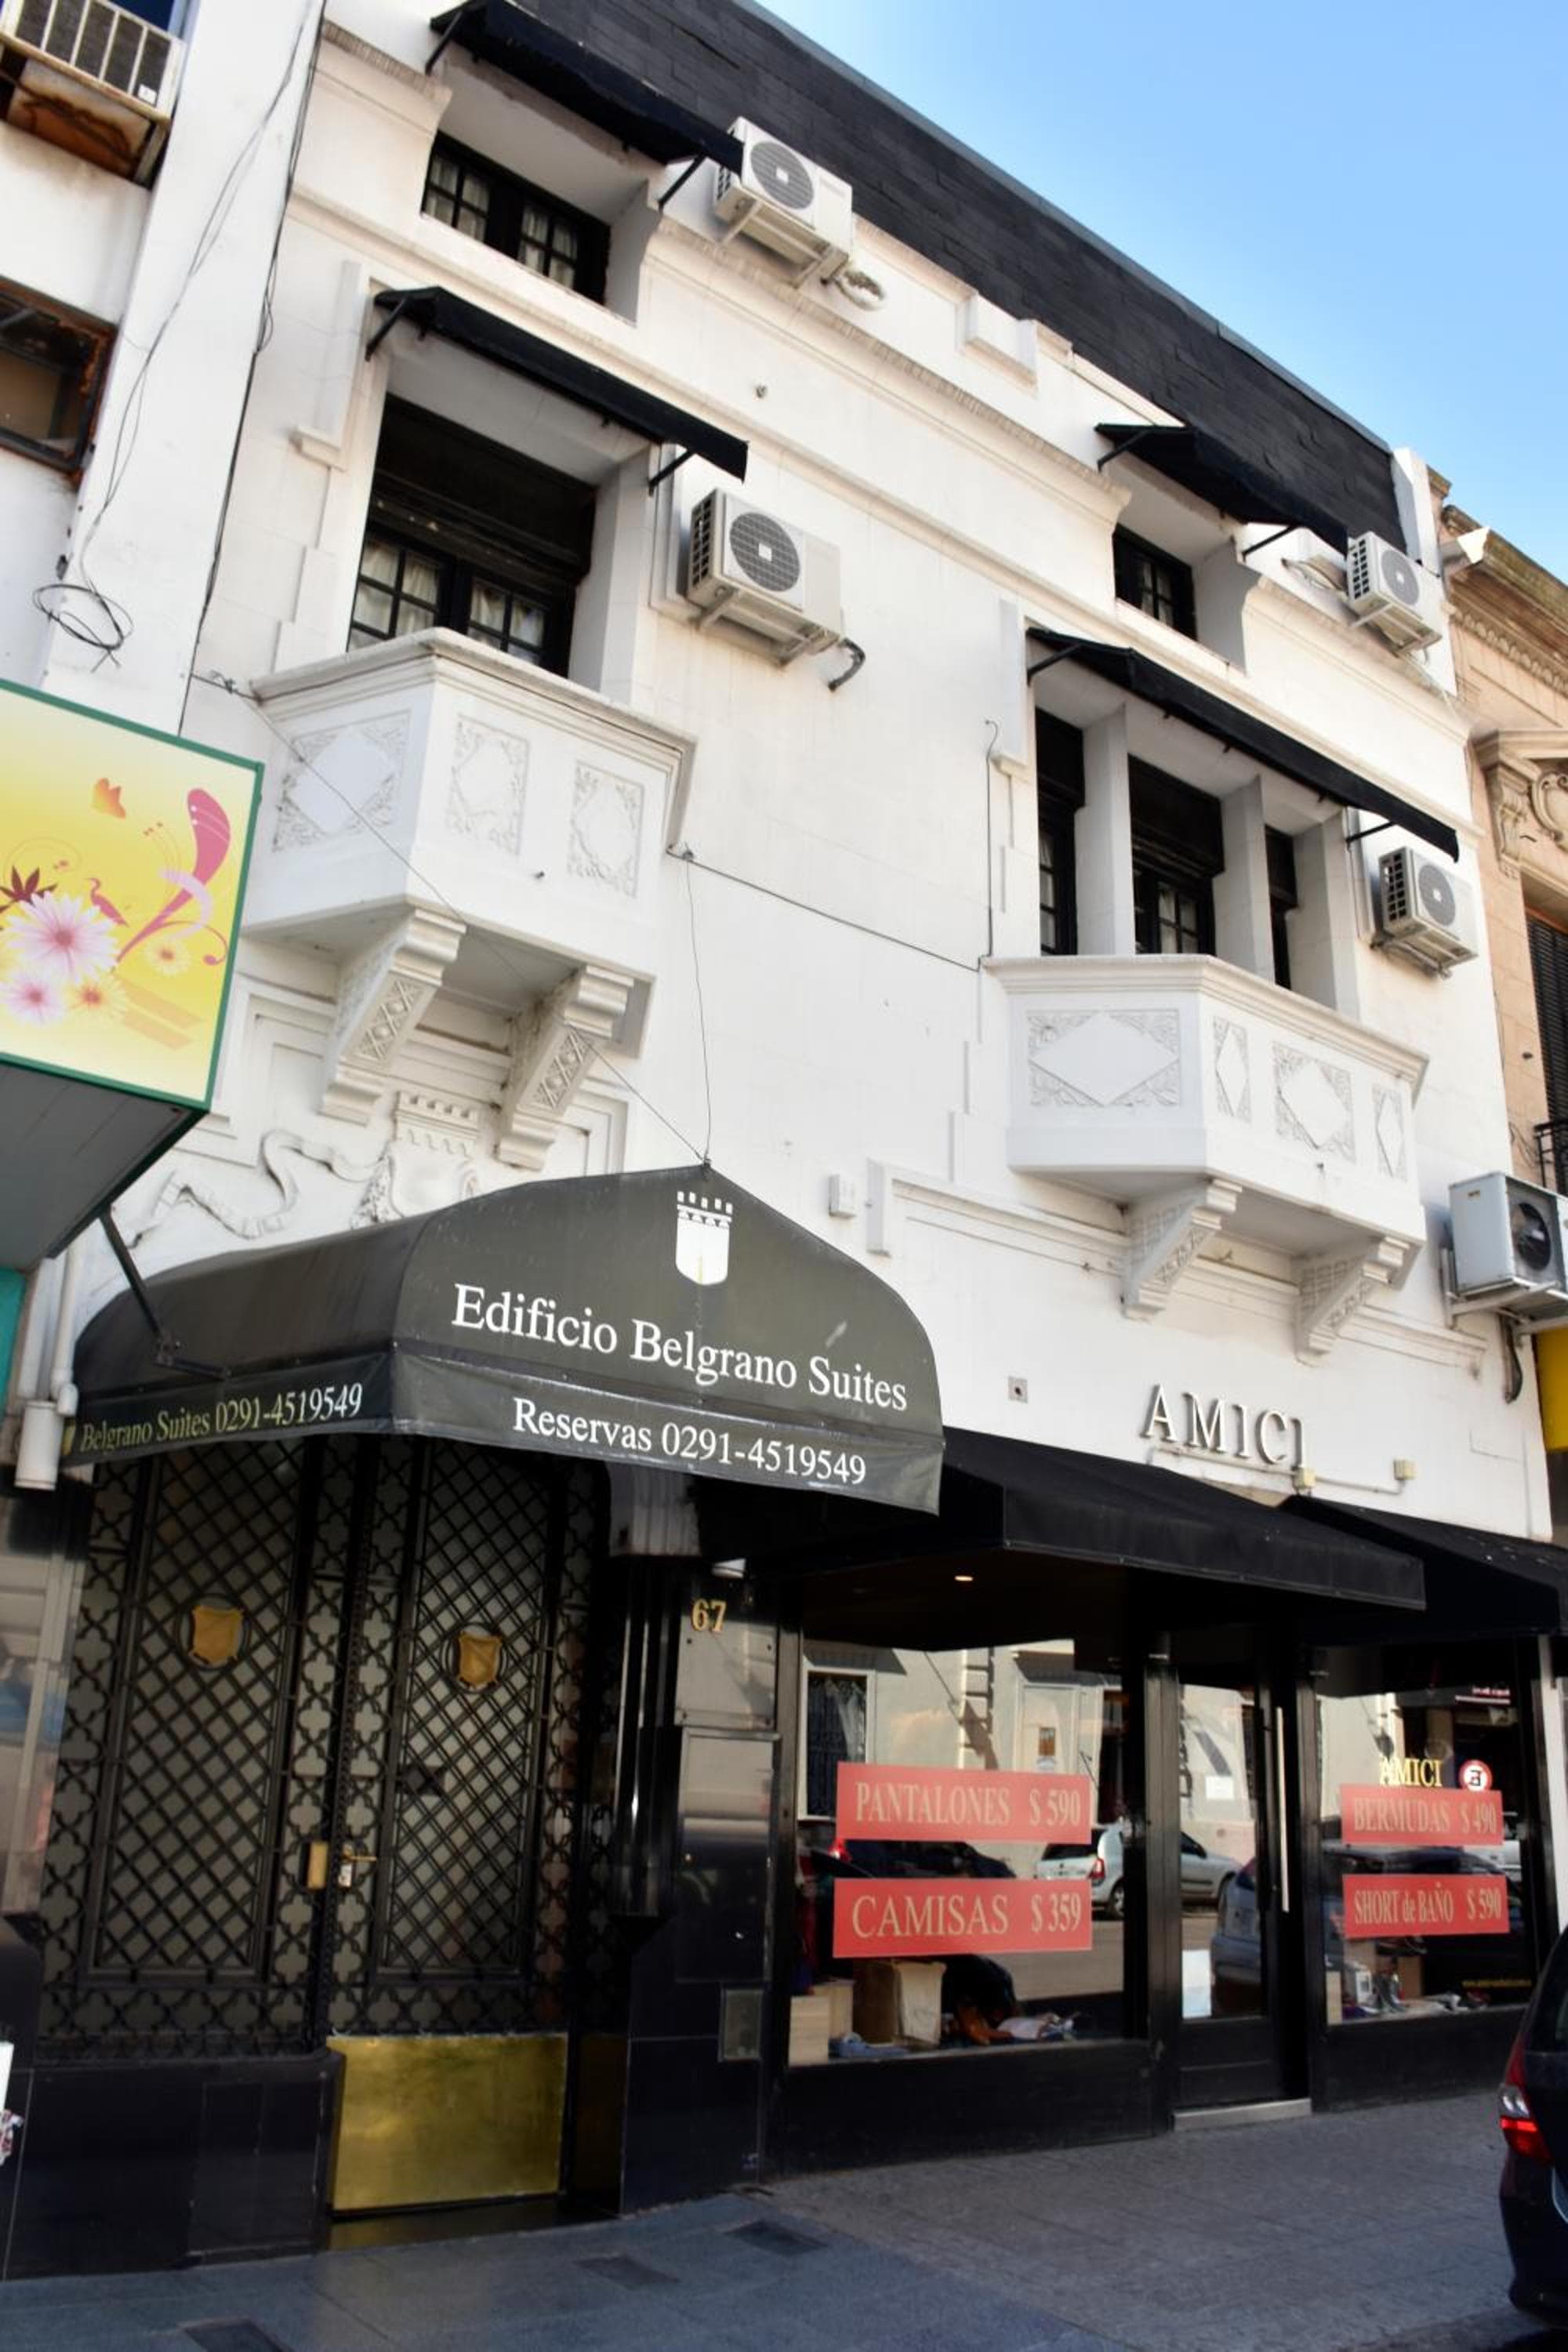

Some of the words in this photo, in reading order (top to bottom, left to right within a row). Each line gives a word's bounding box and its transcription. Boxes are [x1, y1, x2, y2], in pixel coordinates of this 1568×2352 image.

[452, 1283, 618, 1355] Edificio
[630, 1319, 797, 1386] Belgrano
[808, 1356, 908, 1410] Suites
[79, 1421, 153, 1455] Belgrano
[156, 1407, 210, 1443] Suites
[215, 1382, 364, 1433] 0291-4519549
[512, 1397, 652, 1451] Reservas
[662, 1421, 866, 1484] 0291-4519549
[1140, 1383, 1307, 1469] AMICI
[691, 1599, 727, 1632] 67
[1379, 1757, 1443, 1788] AMICI
[855, 1781, 1012, 1826] PANTALONES
[1047, 1789, 1082, 1826] 590
[1354, 1797, 1450, 1833] BERMUDAS
[852, 1894, 1009, 1939] CAMISAS
[1048, 1892, 1082, 1933] 359
[1354, 1889, 1400, 1924] SHORT
[1403, 1890, 1416, 1922] de
[1479, 1887, 1502, 1920] 590
